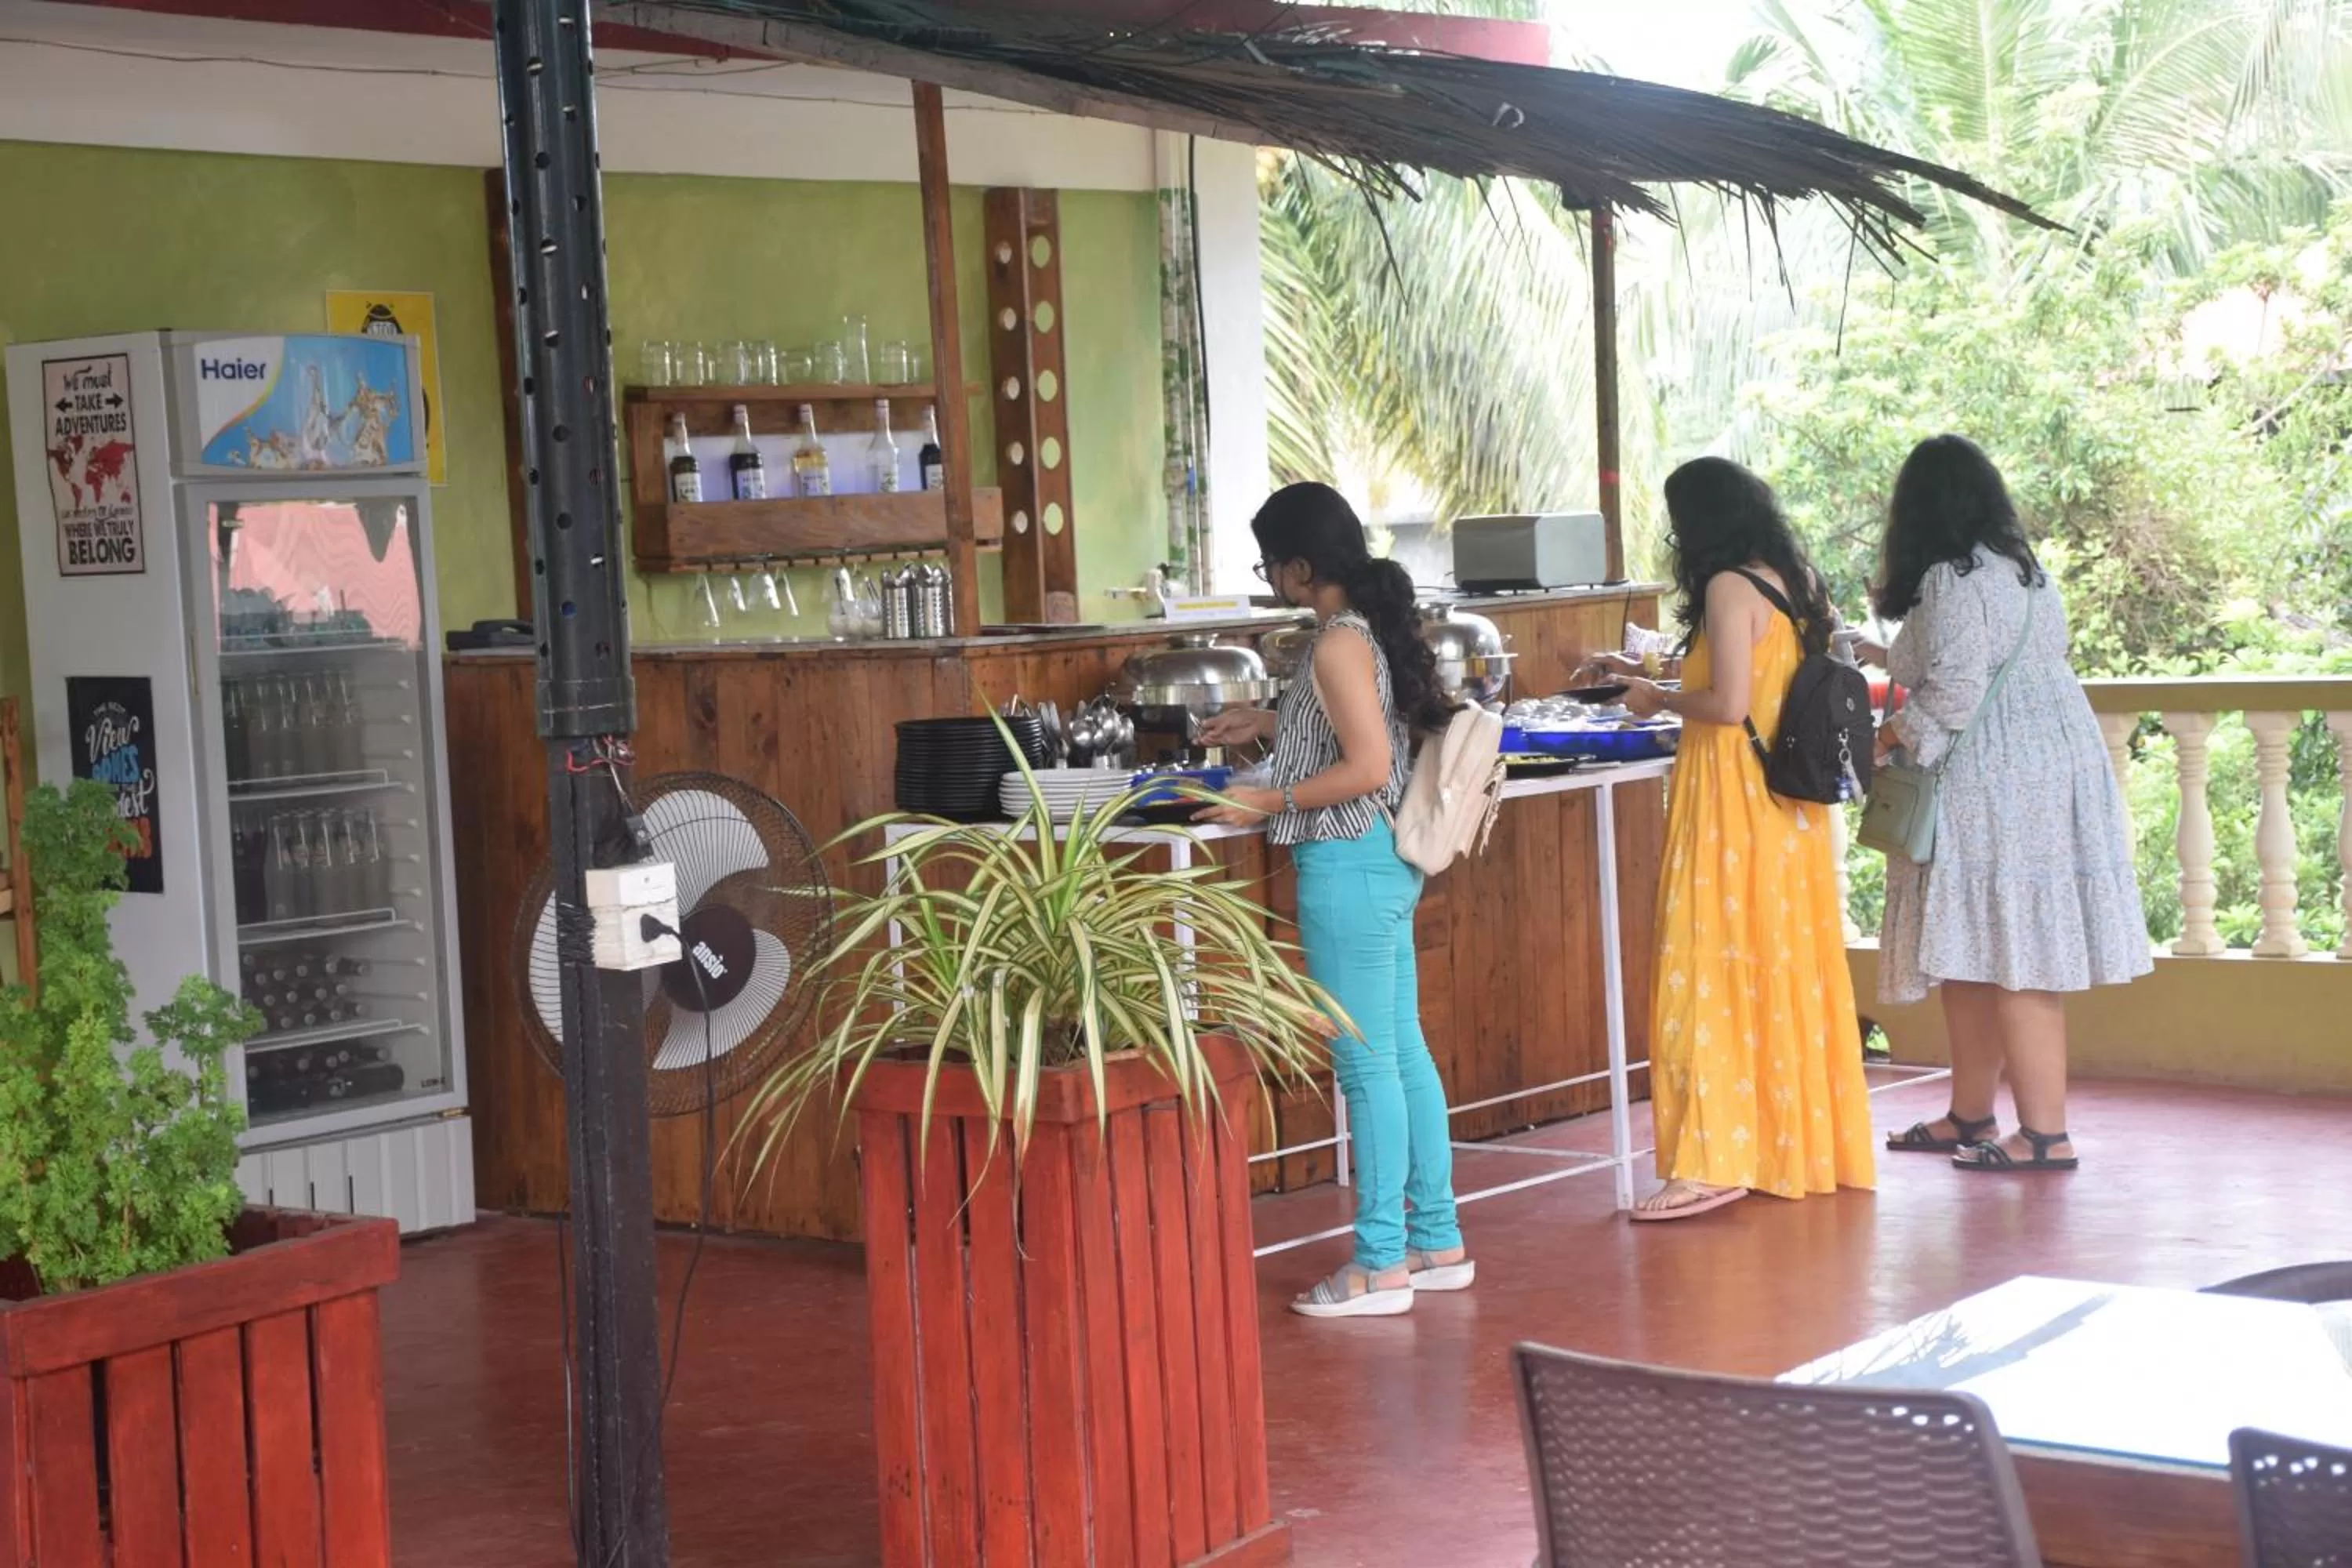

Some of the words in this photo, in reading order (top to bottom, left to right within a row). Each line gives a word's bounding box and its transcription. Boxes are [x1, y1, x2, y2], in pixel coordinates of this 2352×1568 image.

[201, 358, 266, 379] Haier
[75, 393, 103, 412] TAKE
[56, 412, 126, 436] ADVENTURES
[68, 537, 136, 564] BELONG
[85, 715, 140, 763] View
[692, 941, 724, 979] ansio
